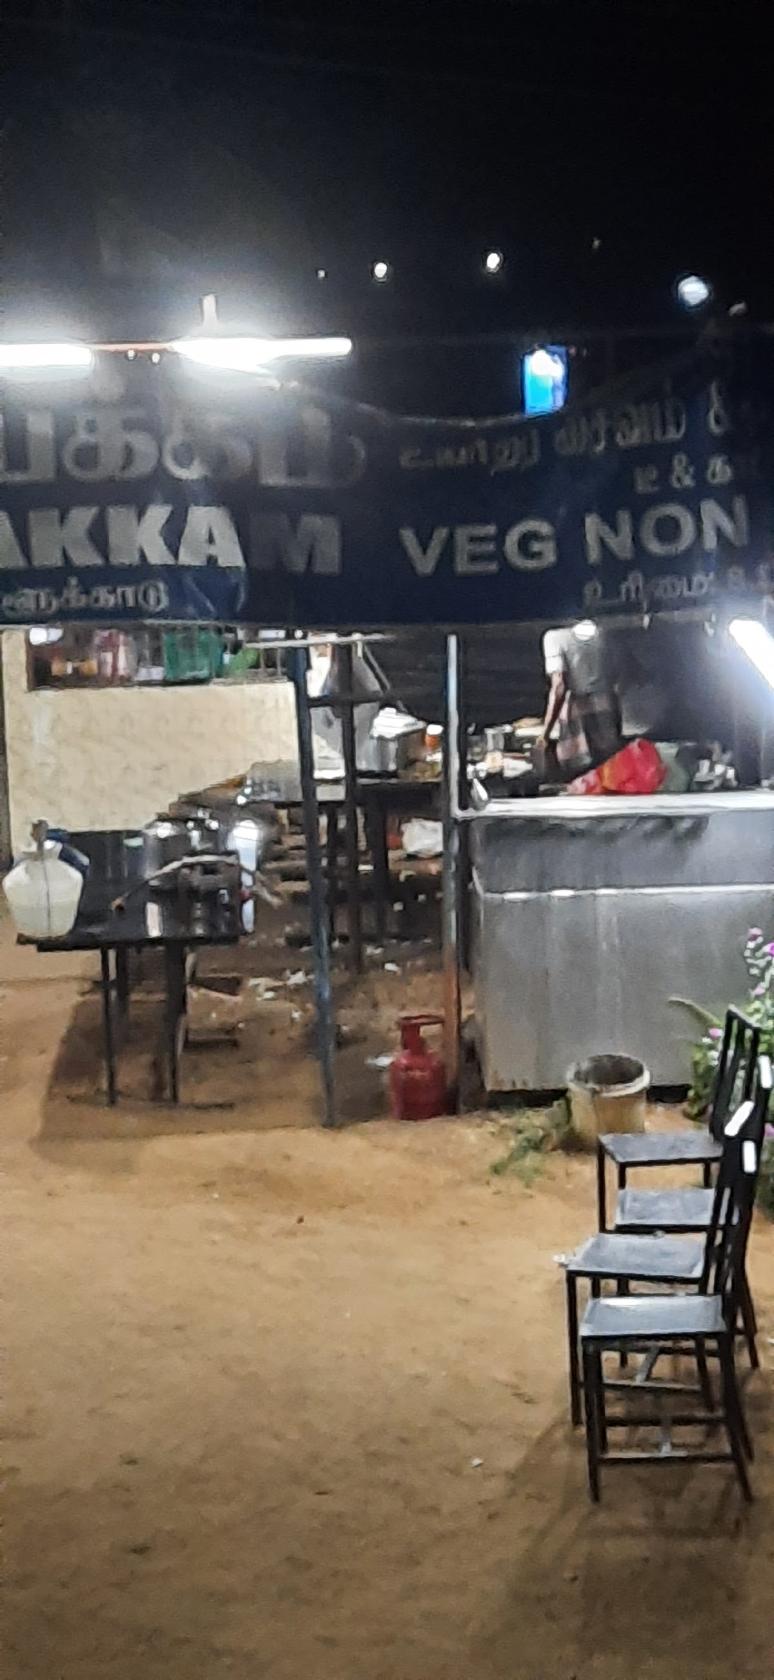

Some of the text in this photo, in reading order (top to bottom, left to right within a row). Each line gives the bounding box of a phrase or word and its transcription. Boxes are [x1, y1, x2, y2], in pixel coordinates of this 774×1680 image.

[670, 452, 697, 489] &
[398, 496, 748, 577] VEG NON
